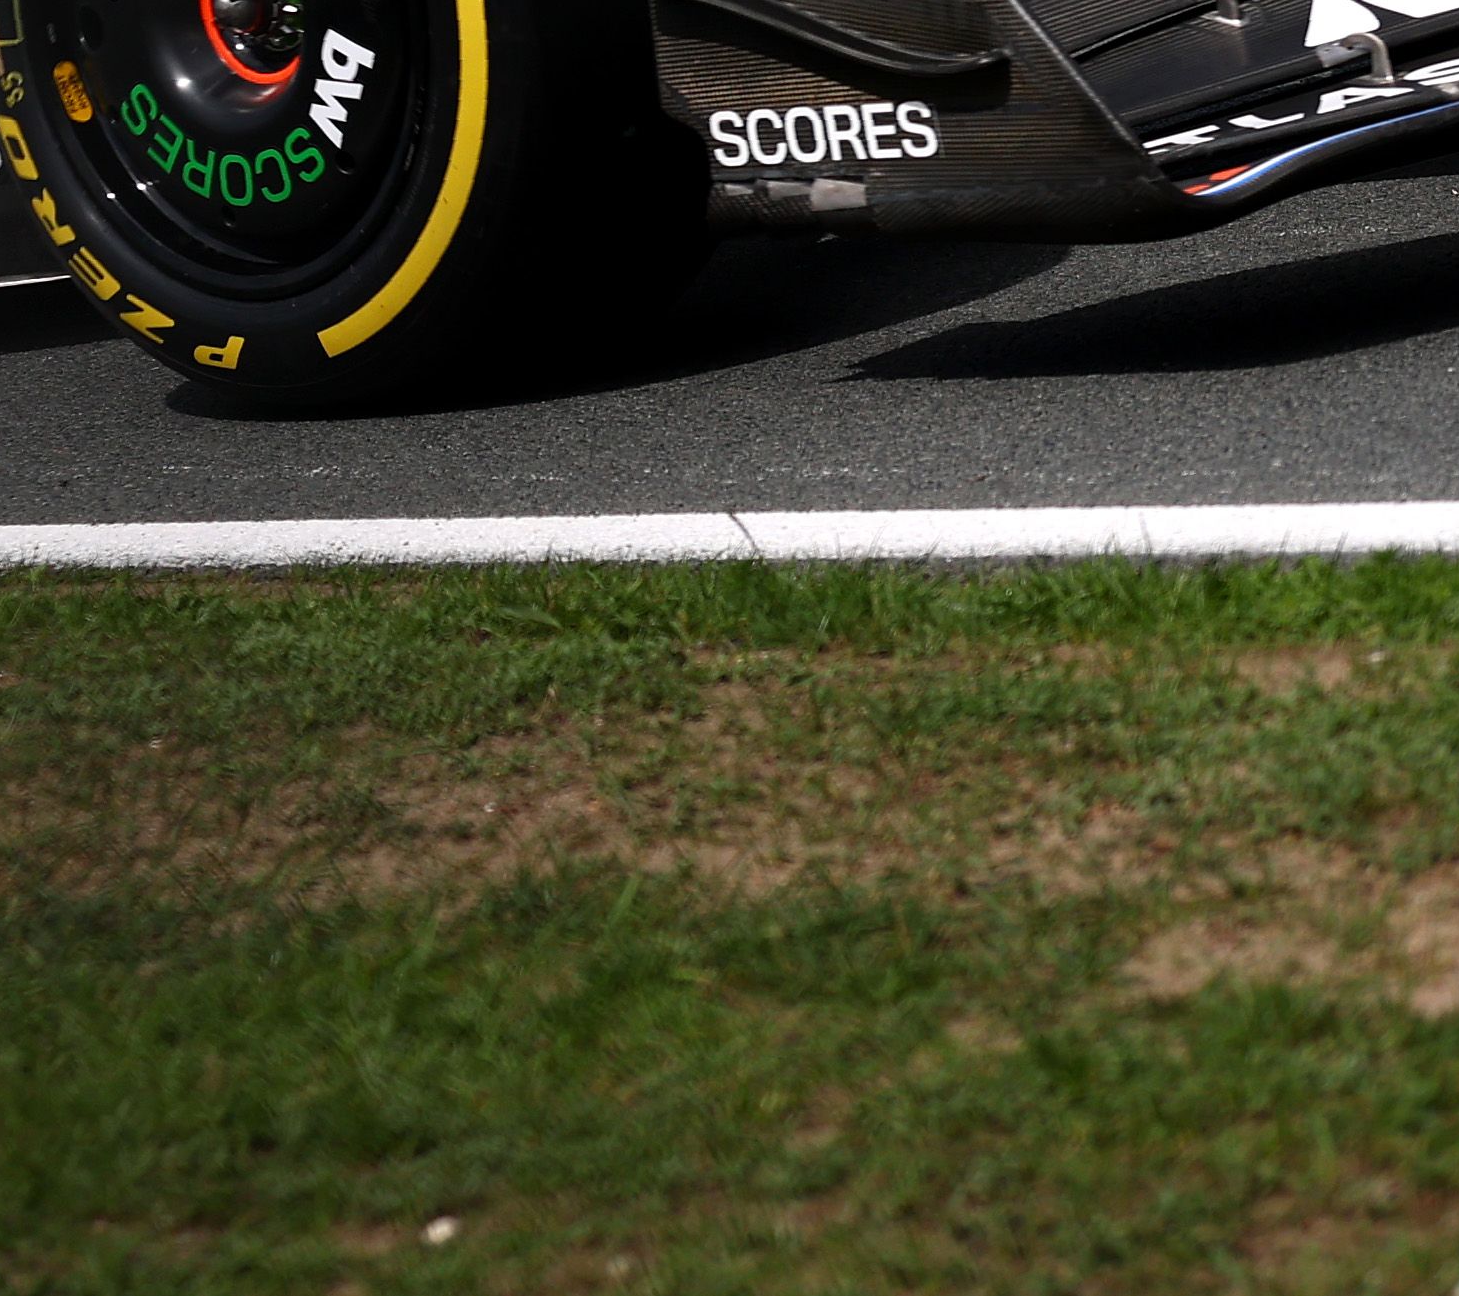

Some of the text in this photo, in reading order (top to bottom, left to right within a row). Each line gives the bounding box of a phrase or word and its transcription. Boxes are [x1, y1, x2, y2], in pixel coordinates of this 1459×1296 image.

[120, 27, 376, 207] bw SCORES
[708, 100, 939, 167] SCORES
[193, 335, 245, 370] P
